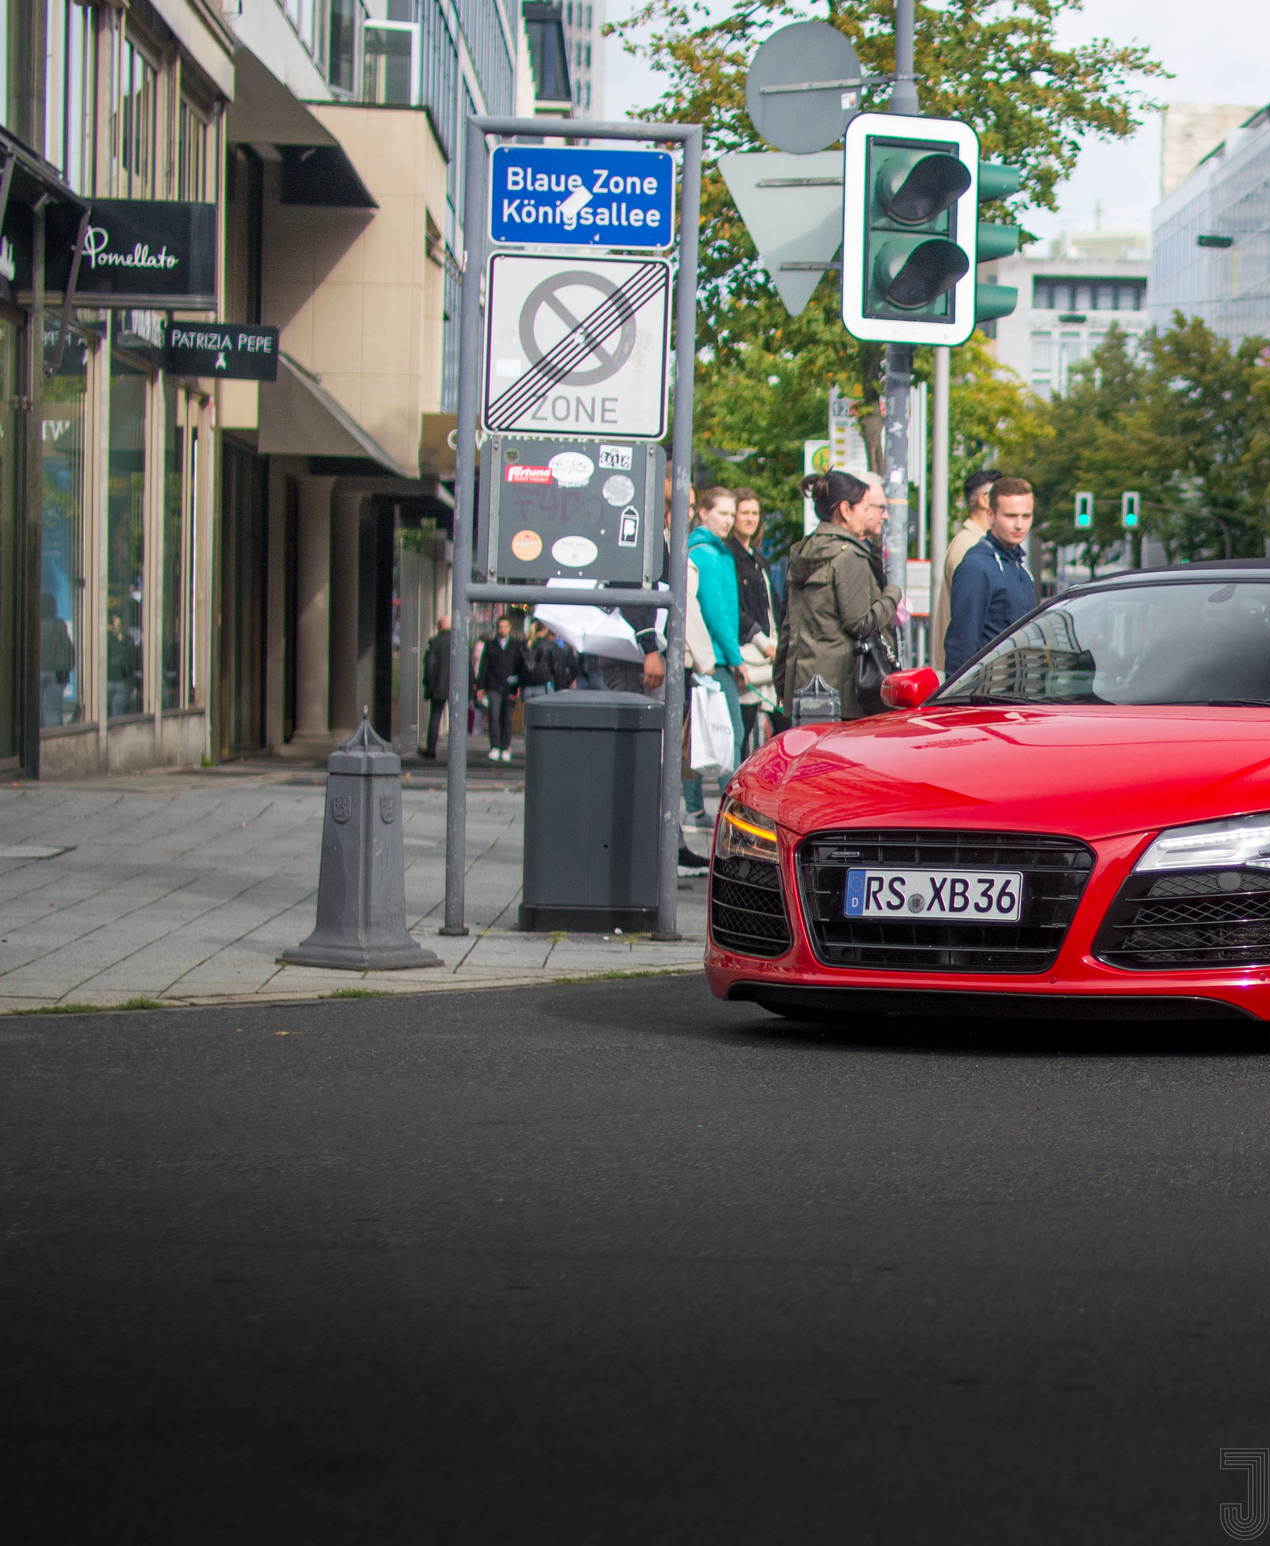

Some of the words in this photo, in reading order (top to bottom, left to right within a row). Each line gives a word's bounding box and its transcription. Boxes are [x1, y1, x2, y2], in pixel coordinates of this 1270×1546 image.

[506, 167, 583, 193] Blaue
[592, 169, 658, 195] Zone
[502, 199, 661, 230] Königsallee
[80, 225, 179, 270] Pomellato
[171, 329, 234, 352] PATRIZIA
[237, 333, 273, 354] PEPE
[531, 395, 618, 424] ZONE
[851, 897, 859, 908] D
[865, 876, 906, 911] RS
